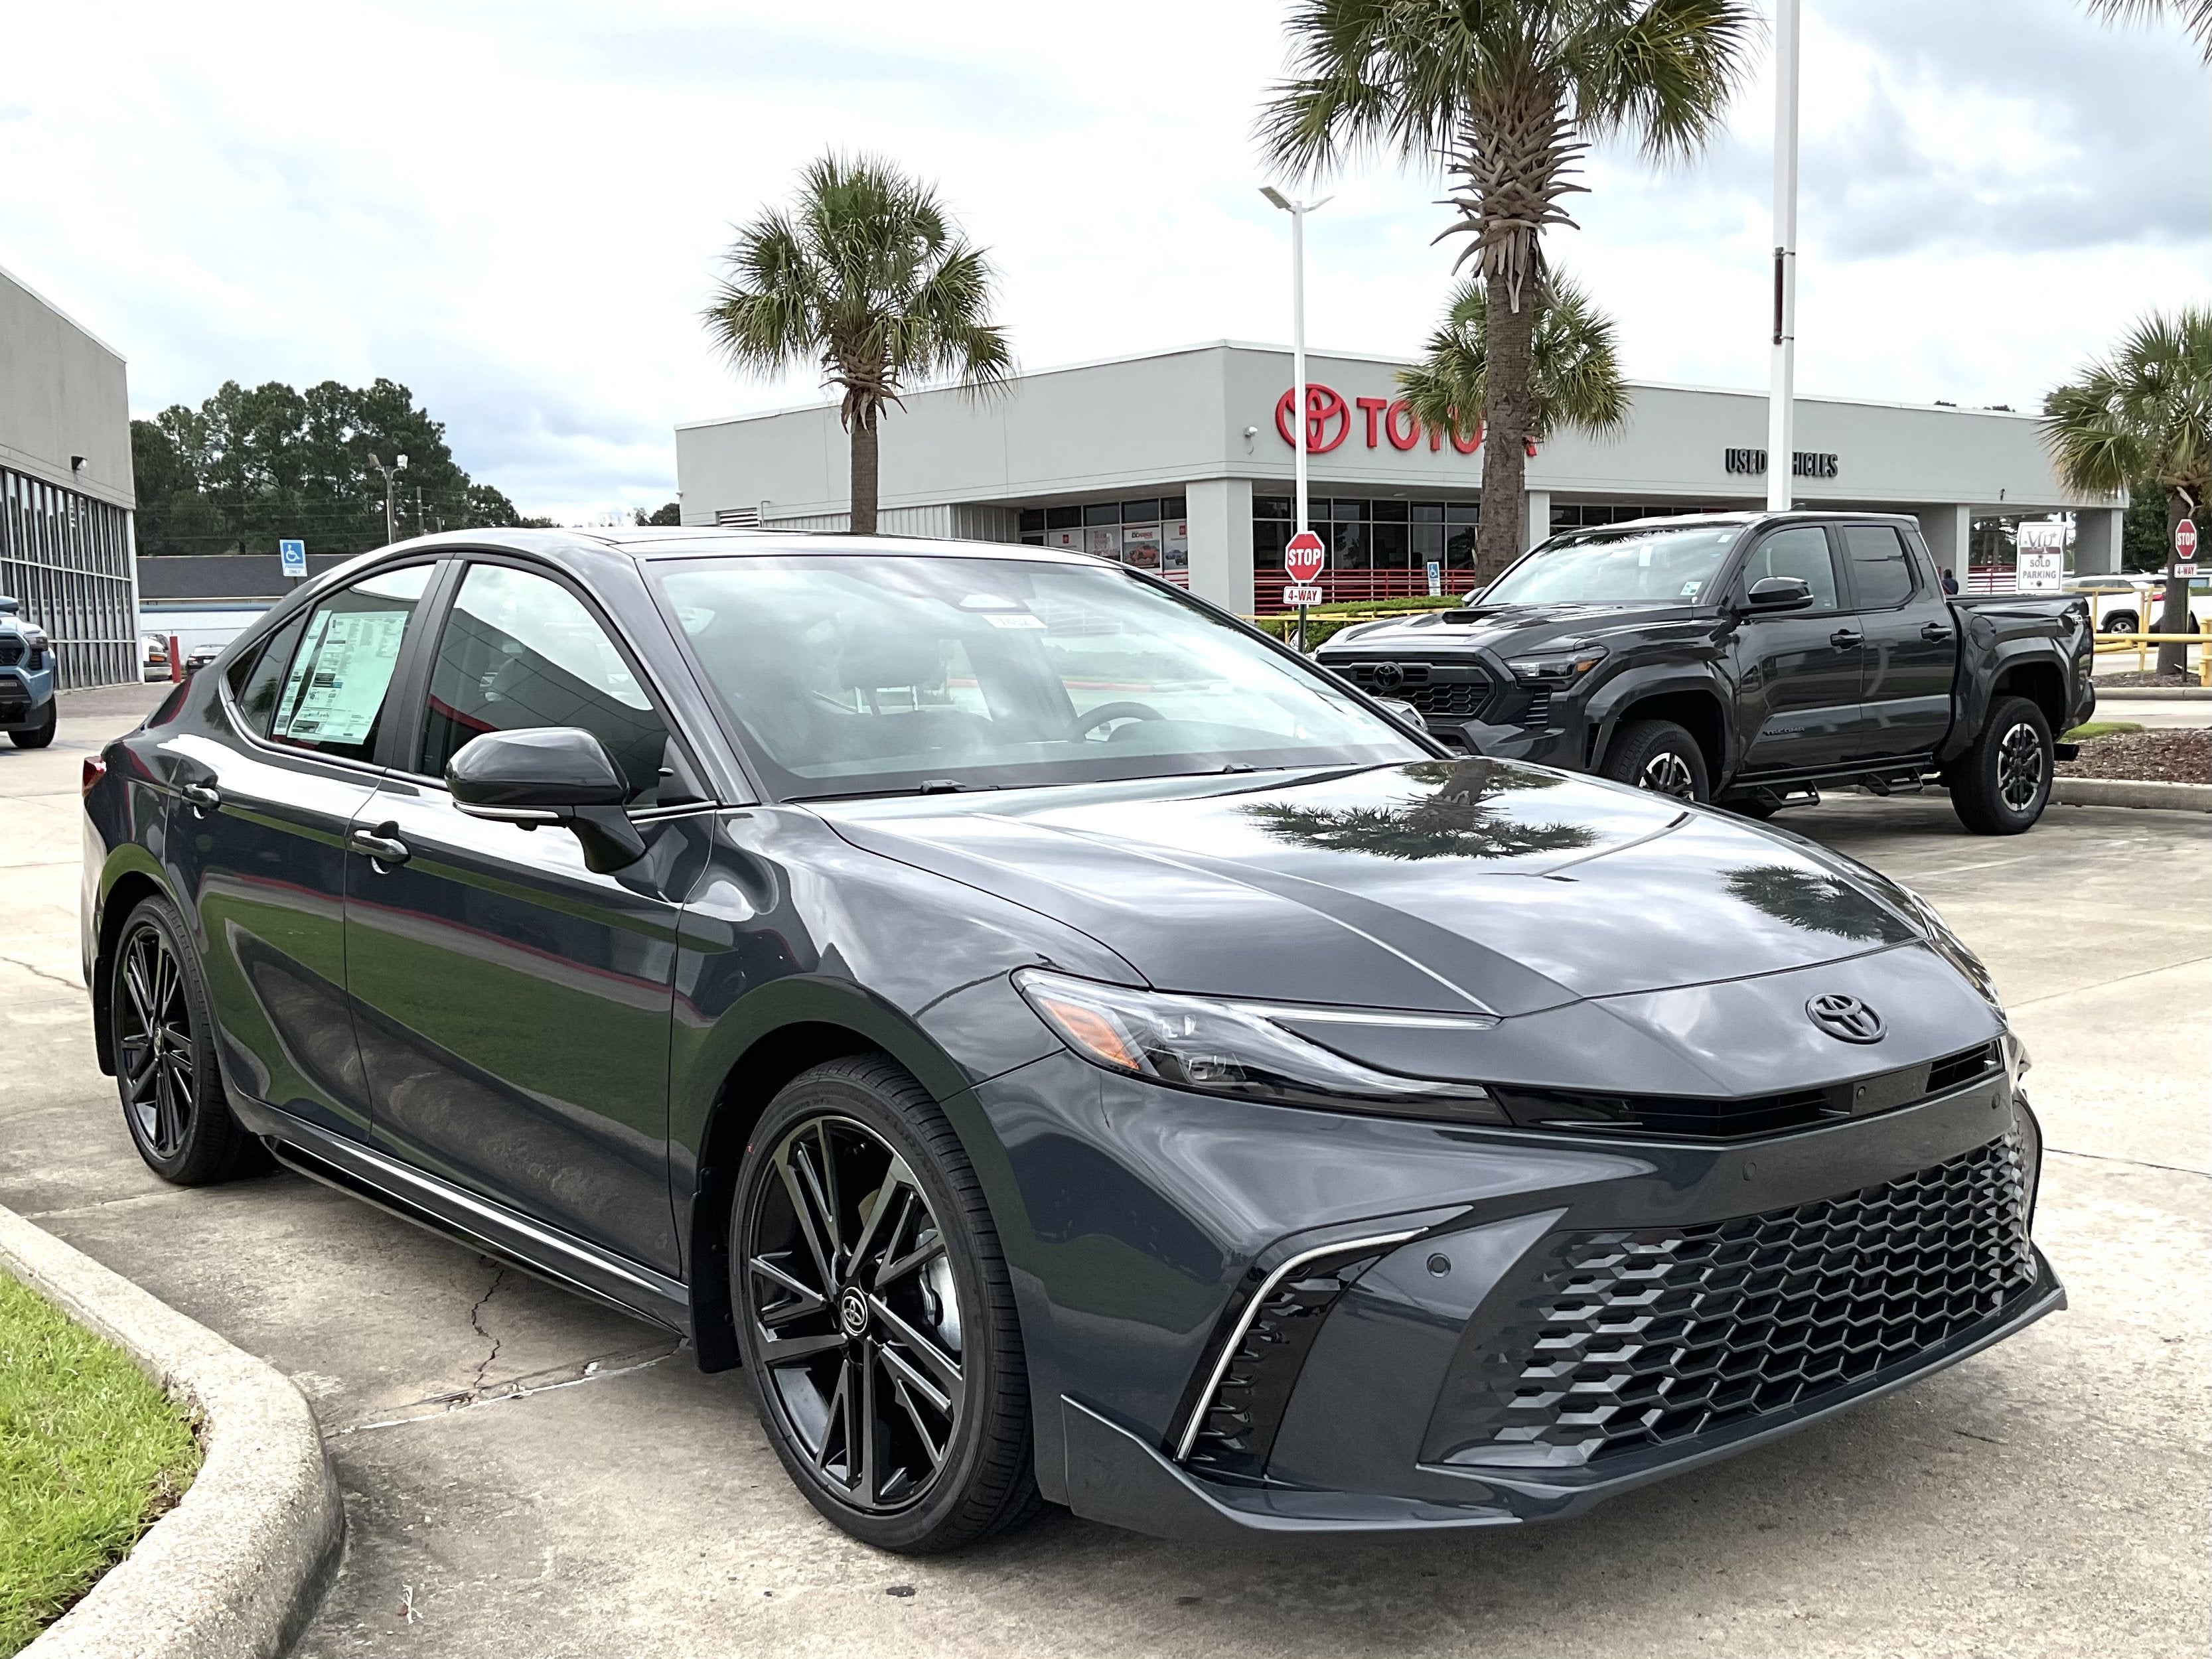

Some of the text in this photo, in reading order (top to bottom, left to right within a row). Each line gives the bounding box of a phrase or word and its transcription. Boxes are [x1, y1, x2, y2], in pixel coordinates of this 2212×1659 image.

[1726, 448, 1838, 477] USED HICLES
[2177, 532, 2195, 546] STOP
[1288, 548, 1321, 566] STOP
[2177, 566, 2194, 575] 4-WAY
[1288, 589, 1317, 601] 4-WAY
[1762, 727, 1805, 736] TACOMA
